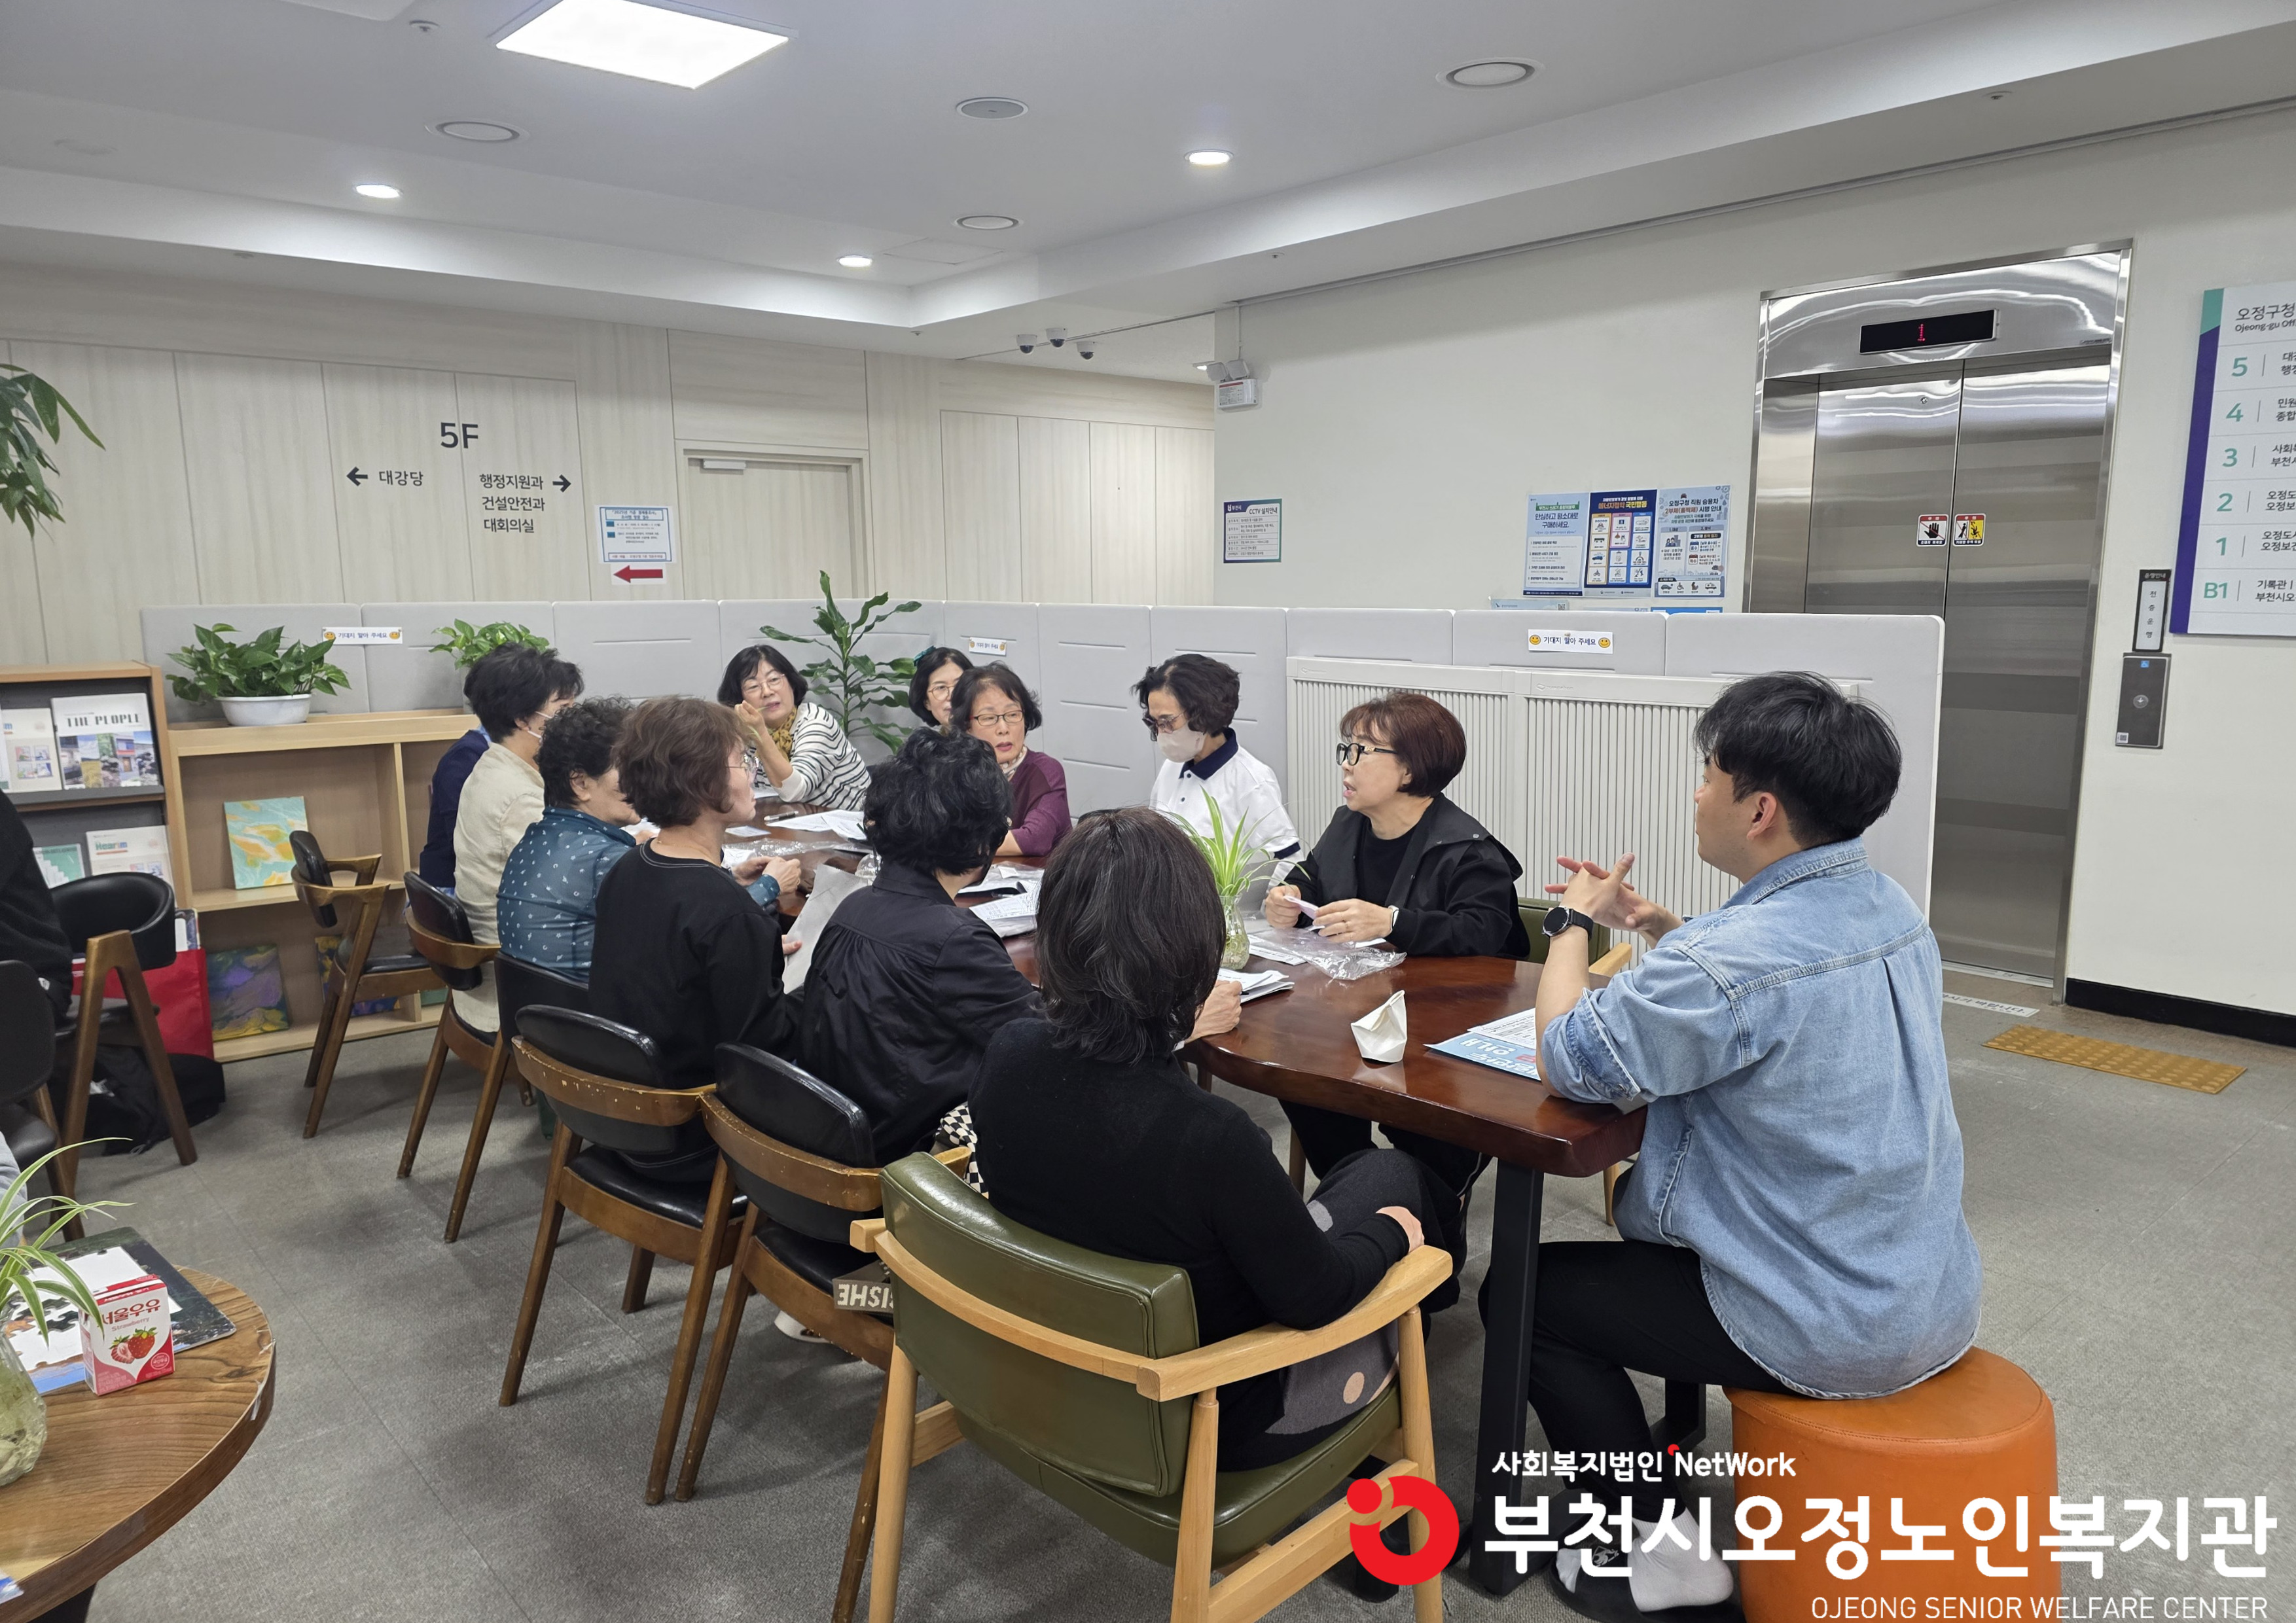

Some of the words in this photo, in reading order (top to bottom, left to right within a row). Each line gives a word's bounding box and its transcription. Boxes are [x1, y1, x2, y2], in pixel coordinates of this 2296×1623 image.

[2235, 302, 2295, 321] 오정구청
[1917, 323, 1926, 341] 1
[2231, 357, 2248, 377] 5
[2226, 402, 2244, 422] 4
[440, 422, 478, 449] 5F
[2222, 448, 2238, 467] 3
[379, 470, 424, 486] 대강당
[479, 473, 544, 490] 행정지원과
[482, 496, 545, 511] 건설안전과
[2217, 493, 2233, 512] 2
[484, 518, 535, 533] 대회의실
[2215, 537, 2227, 556] 1
[2203, 582, 2228, 599] B1
[837, 1283, 894, 1309] ISHE
[111, 1317, 150, 1332] Strawberry
